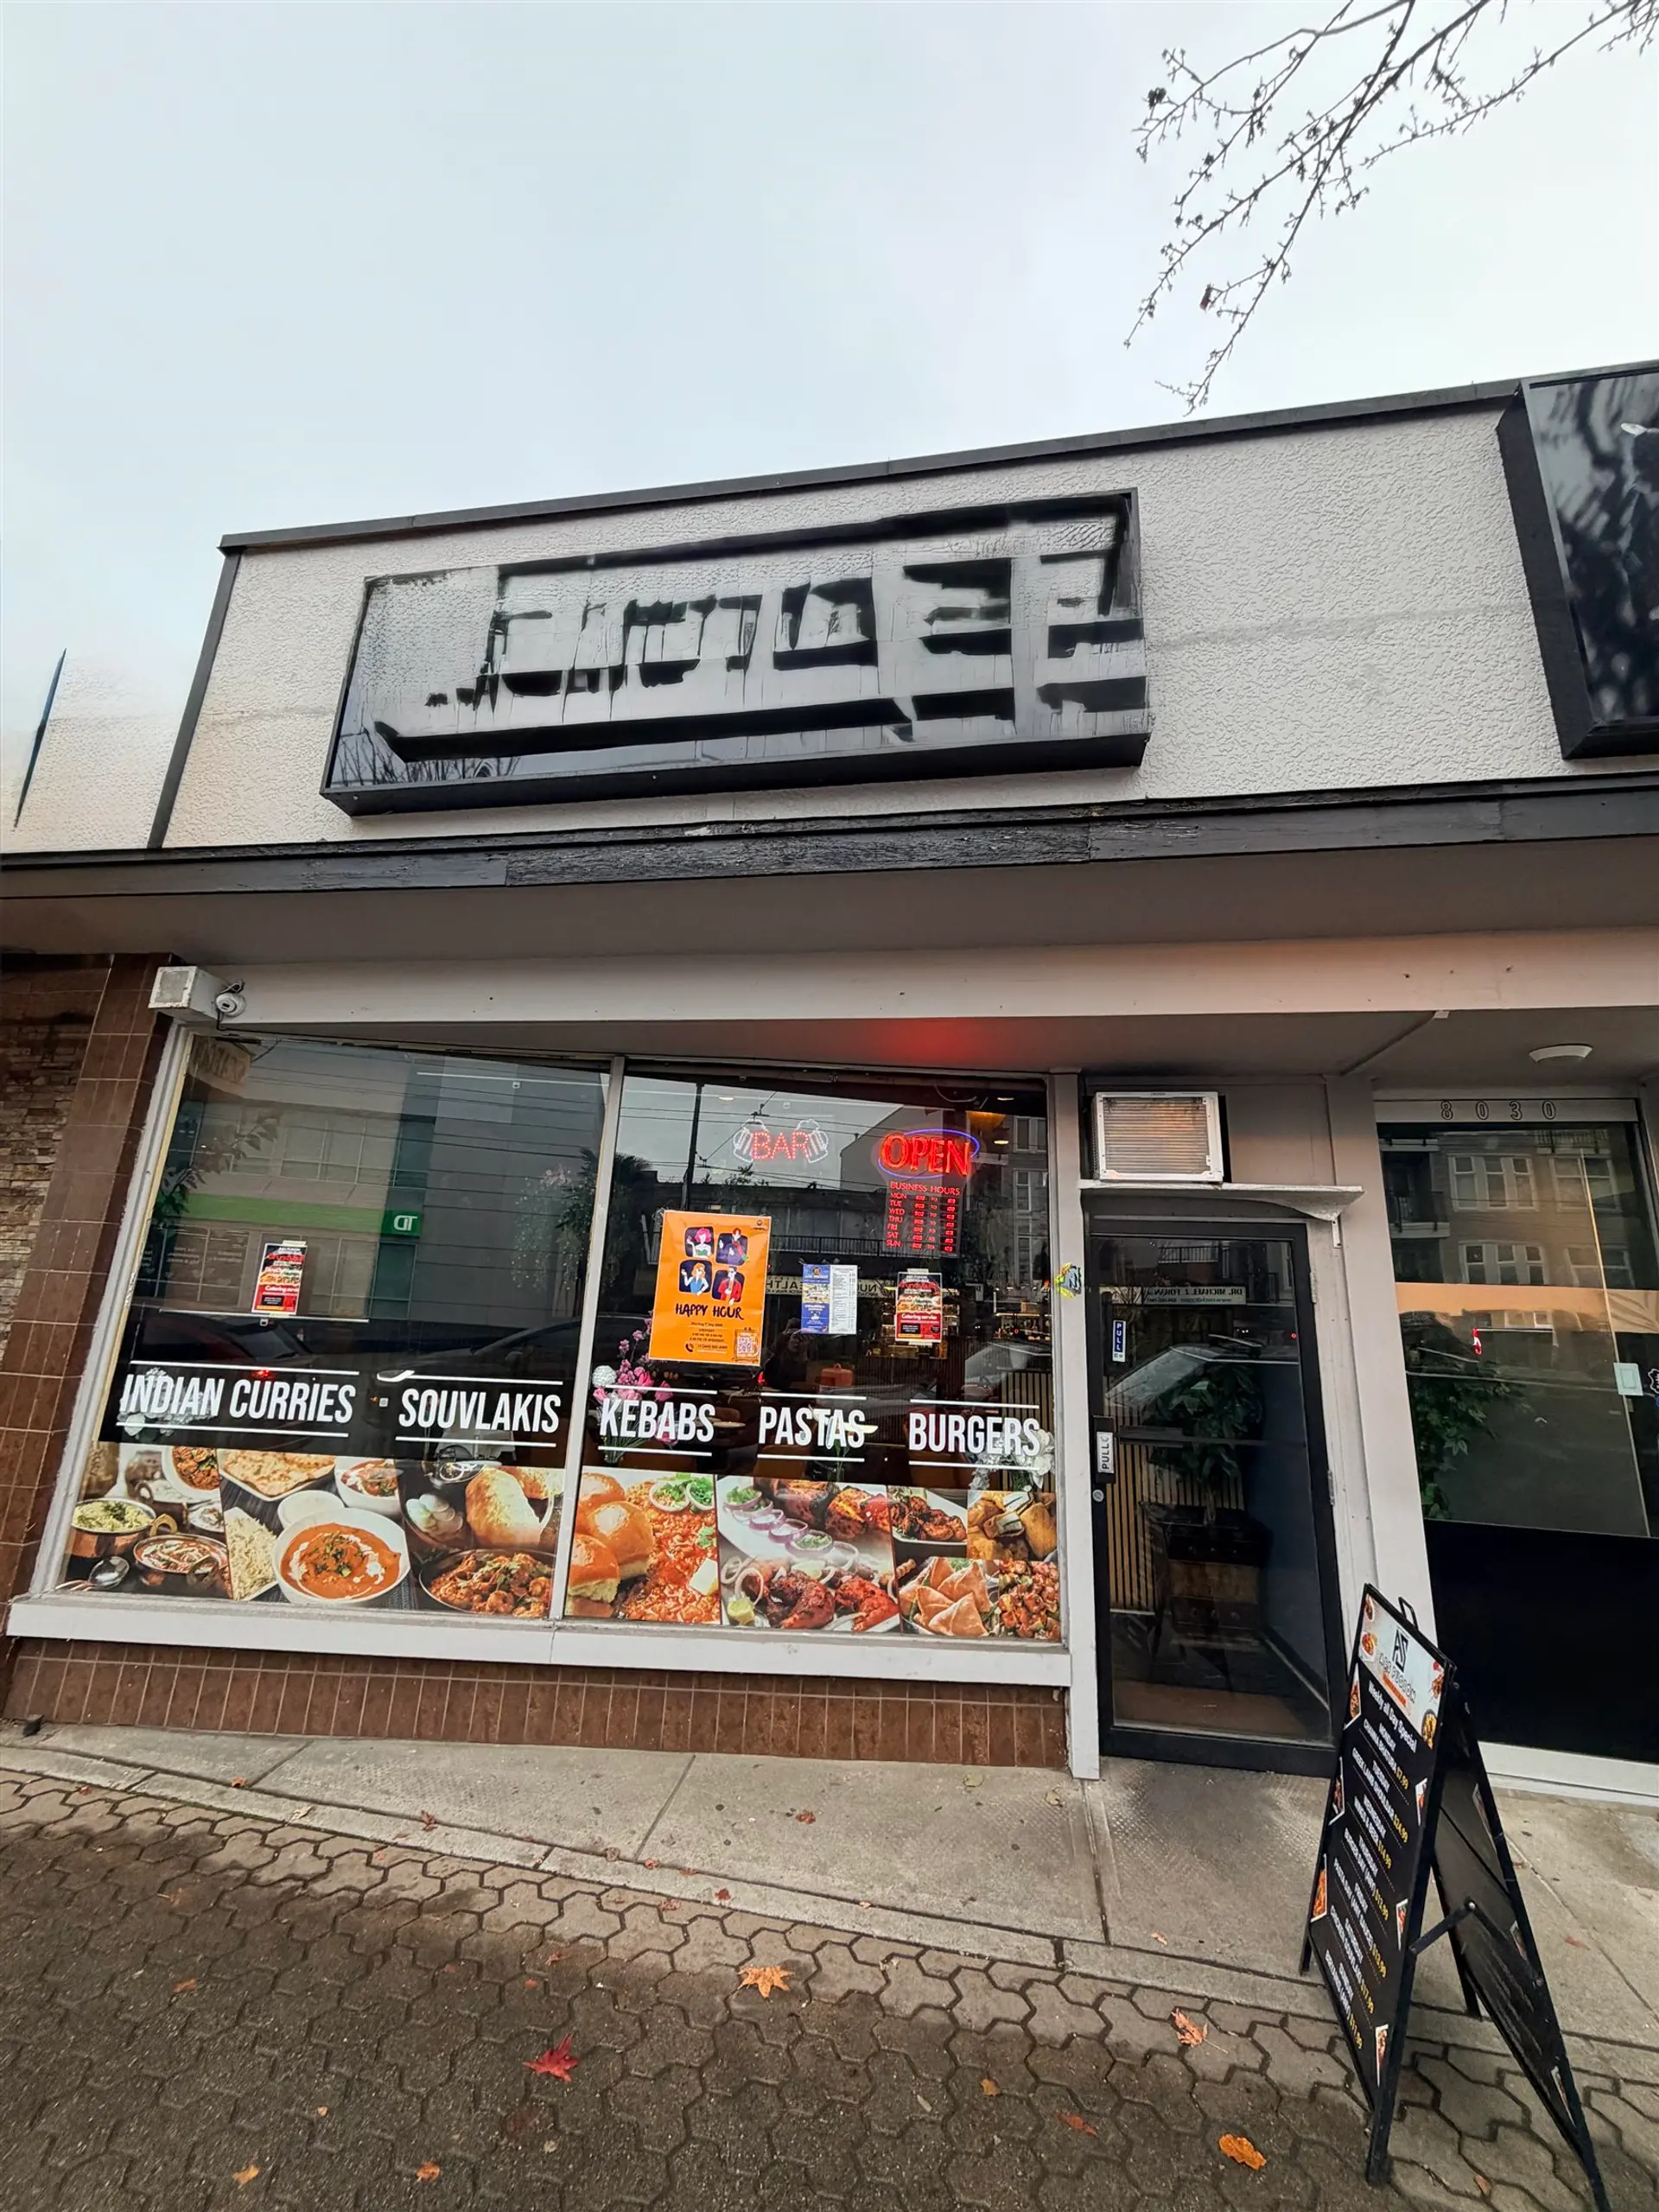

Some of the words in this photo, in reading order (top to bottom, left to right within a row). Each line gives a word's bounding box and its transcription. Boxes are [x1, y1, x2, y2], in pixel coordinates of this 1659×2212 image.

[1440, 1100, 1556, 1120] 8030
[753, 1131, 810, 1160] BAR
[881, 1133, 970, 1176] OPEN
[890, 1181, 927, 1192] BUSINESS
[930, 1185, 961, 1196] HOURS
[676, 1303, 708, 1317] HAPPY
[713, 1306, 744, 1319] HOUR
[119, 1374, 225, 1418] INDIAN
[229, 1380, 356, 1424] CURRIES
[398, 1388, 561, 1434] SOUVLAKIS
[600, 1398, 715, 1443] KEBABS
[759, 1406, 867, 1449] PASTAS
[908, 1413, 1040, 1458] BURGERS
[1102, 1443, 1110, 1470] PULL
[1369, 1681, 1383, 1710] Weekly
[1389, 1708, 1398, 1730] Day
[1398, 1720, 1417, 1752] Special
[1379, 1723, 1395, 1751] MONDAY
